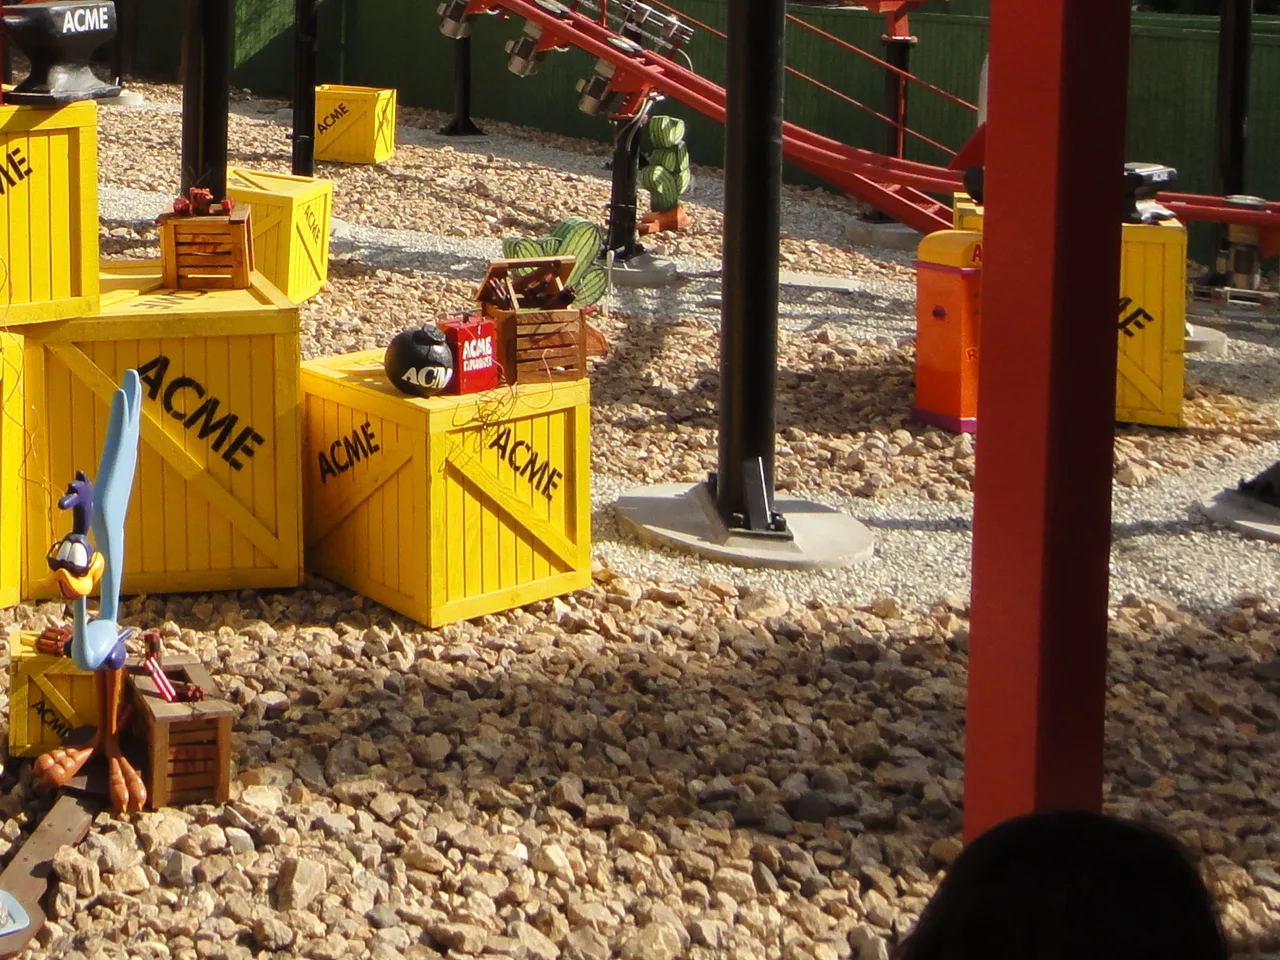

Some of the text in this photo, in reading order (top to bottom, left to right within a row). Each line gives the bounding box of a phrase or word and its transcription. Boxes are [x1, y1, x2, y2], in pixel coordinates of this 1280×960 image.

[62, 6, 109, 34] ACME
[317, 103, 350, 135] ACME
[303, 204, 322, 245] ACME
[462, 335, 493, 360] ACME
[401, 366, 453, 389] ACM
[136, 354, 265, 471] ACME
[317, 421, 381, 484] ACME
[488, 426, 563, 501] ACME
